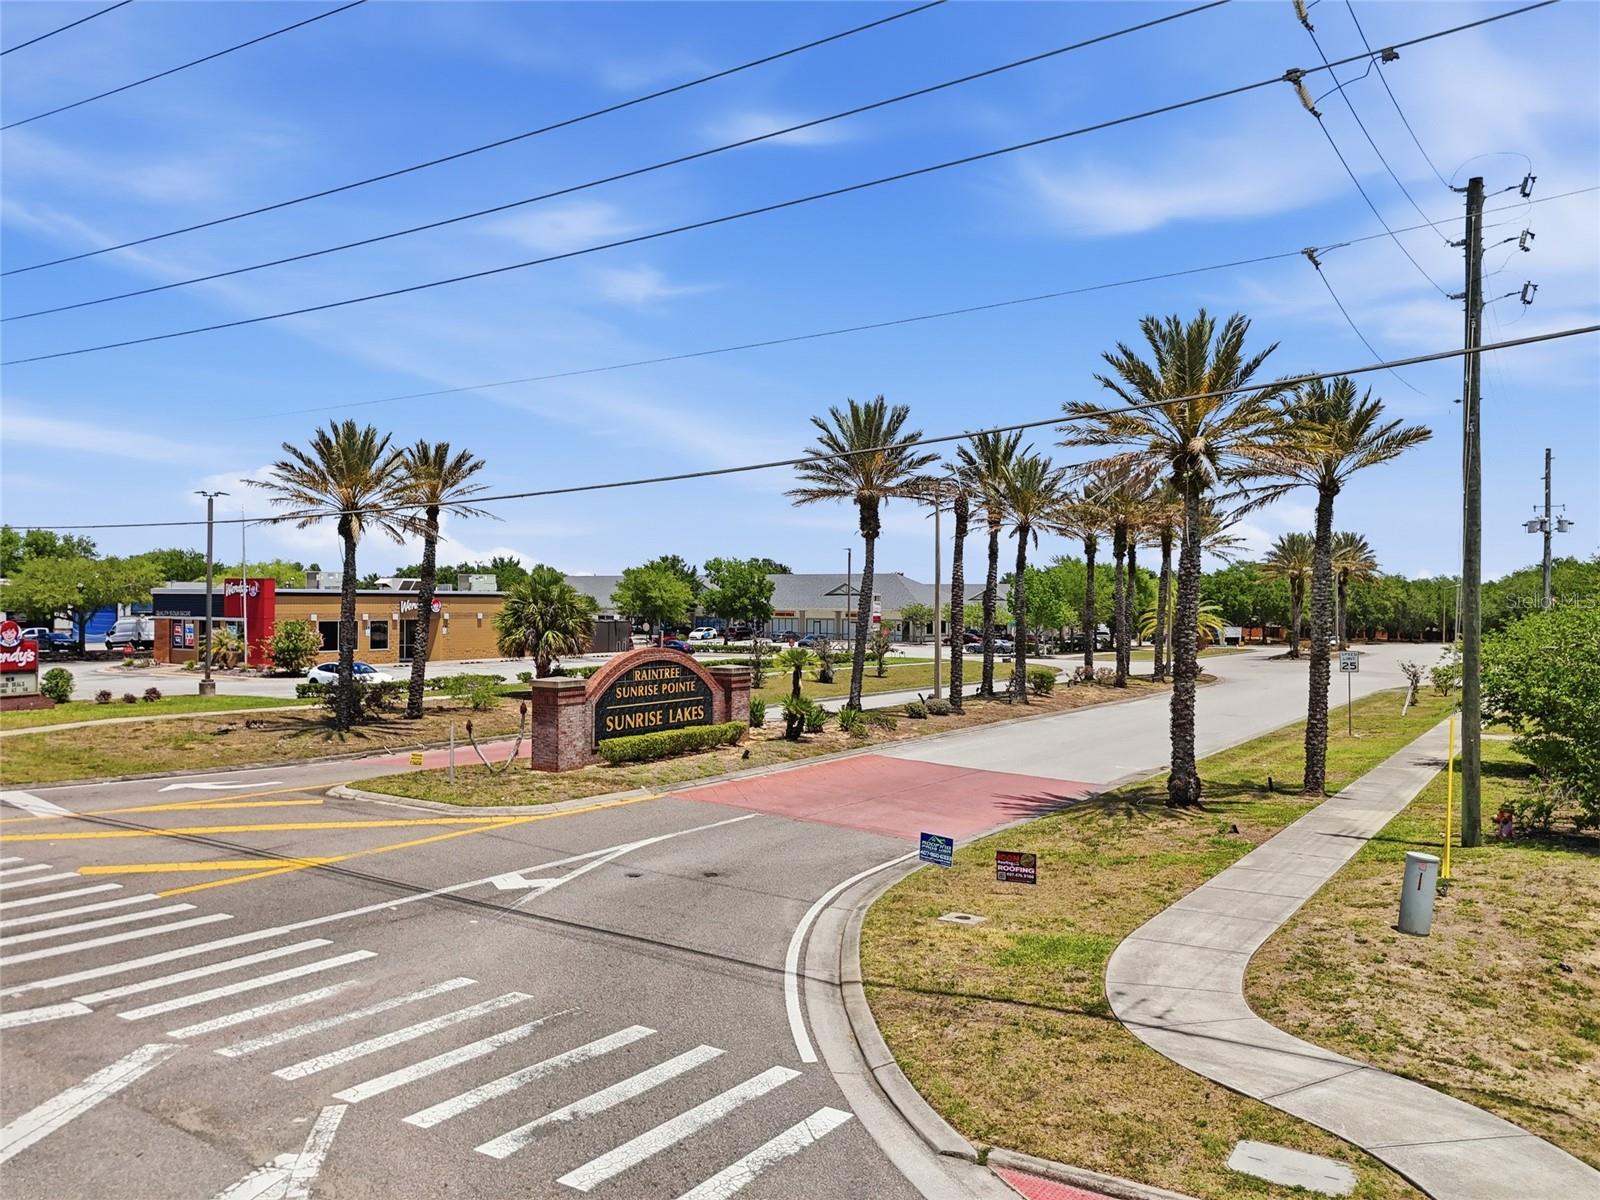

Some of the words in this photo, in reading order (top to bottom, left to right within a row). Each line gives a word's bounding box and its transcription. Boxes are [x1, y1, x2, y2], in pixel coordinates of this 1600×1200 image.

[1342, 661, 1357, 670] 25
[634, 667, 680, 681] RAINTREE
[615, 684, 658, 699] SUNRISE
[661, 680, 696, 694] POINTE
[606, 710, 663, 732] SUNRISE
[668, 705, 704, 723] LAKES
